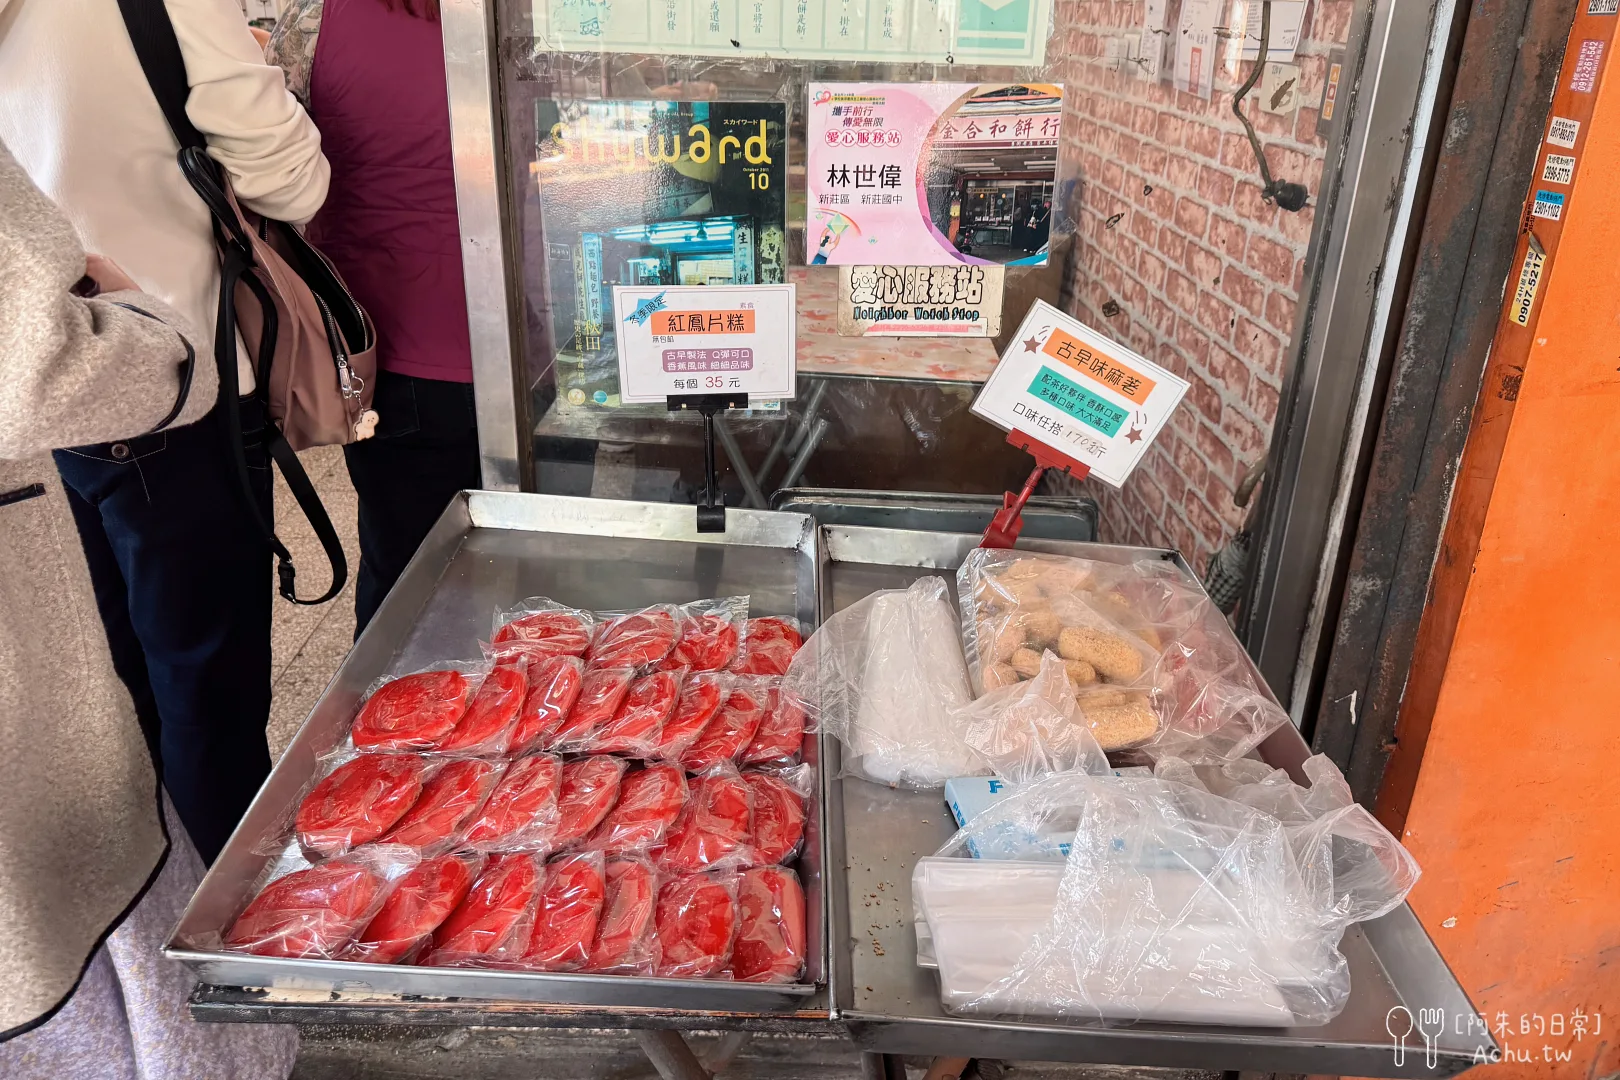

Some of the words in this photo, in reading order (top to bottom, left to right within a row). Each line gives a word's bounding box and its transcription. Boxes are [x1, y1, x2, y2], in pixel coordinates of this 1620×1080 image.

[827, 132, 900, 145] 愛心服務站
[940, 117, 1060, 140] 金合和餅行
[749, 173, 770, 190] 10
[827, 164, 902, 189] 林世偉
[819, 194, 850, 205] 新莊區
[861, 194, 903, 205] 新莊國中
[851, 265, 984, 304] 愛心服務站
[629, 295, 667, 324] 冬季限定
[853, 307, 908, 321] Neighbor
[914, 307, 949, 321] Watch
[952, 307, 980, 321] Stop
[667, 313, 745, 333] 紅鳳片糕
[585, 319, 601, 351] 秋田
[666, 350, 707, 360] 古早製法
[712, 349, 750, 359] Q彈可口
[667, 361, 707, 371] 香蕉風味
[711, 361, 750, 370] 細細品味
[674, 378, 698, 390] 每個
[705, 376, 724, 388] 35
[729, 377, 741, 388] 元
[1041, 373, 1086, 402] 配茶好夥伴
[1086, 398, 1122, 424] 香酥口感
[1012, 402, 1064, 436] 口味任搭
[1039, 388, 1074, 411] 多種口味
[1075, 406, 1112, 432] 大大滿足
